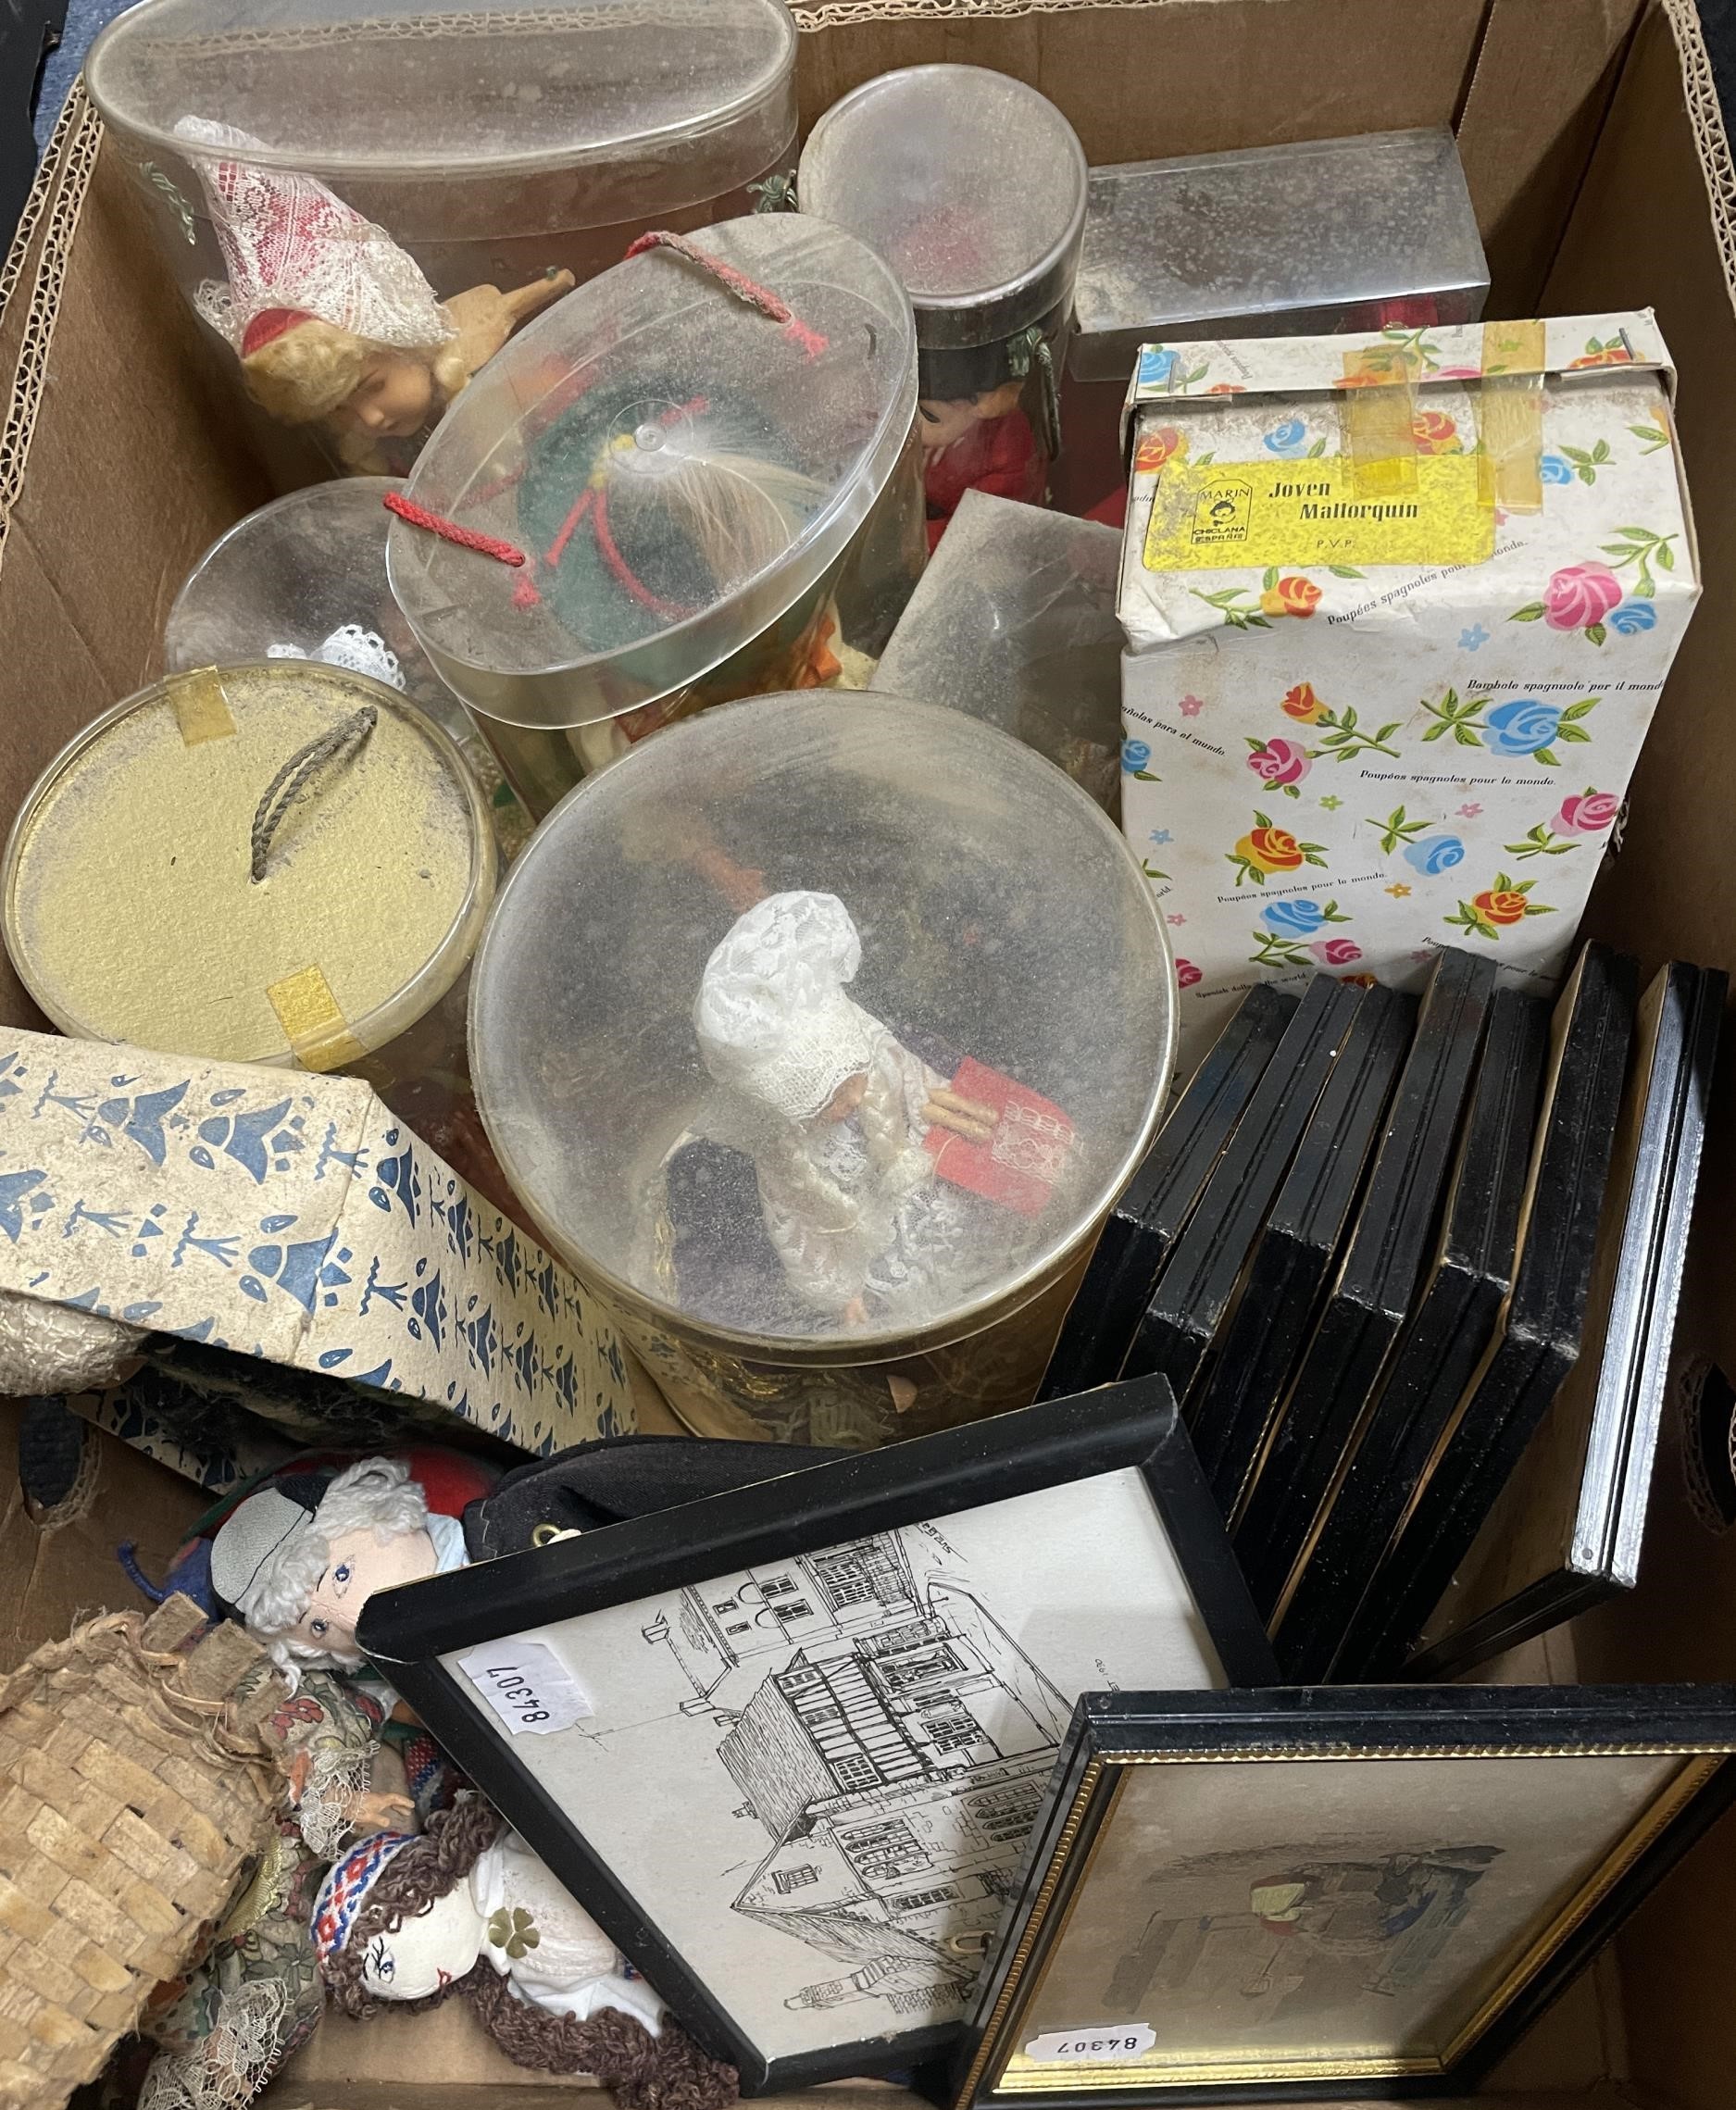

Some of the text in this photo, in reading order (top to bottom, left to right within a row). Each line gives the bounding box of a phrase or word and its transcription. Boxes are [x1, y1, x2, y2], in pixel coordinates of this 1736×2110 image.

[1200, 488, 1250, 501] MARIN
[1268, 481, 1330, 498] Joven
[1300, 503, 1418, 521] Mallorquin
[1193, 526, 1245, 534] CHICLANA
[1328, 599, 1377, 625] Poupées
[1380, 573, 1437, 605] spagnoles
[1467, 680, 1664, 693] Bambole spagnuole per il mond
[1121, 705, 1153, 724] añolas
[1153, 721, 1178, 735] para
[1180, 732, 1192, 741] el
[1359, 769, 1406, 780] Poupées
[1410, 774, 1467, 784] spagnoles
[1468, 777, 1497, 785] pour
[1516, 777, 1556, 786] monde.
[1217, 893, 1257, 903] Poupées
[1260, 886, 1308, 898] spagnoles
[1311, 882, 1334, 892] pour
[1351, 872, 1388, 883] monde.
[486, 1667, 550, 1723] 84307
[1057, 2037, 1137, 2054] 84307
